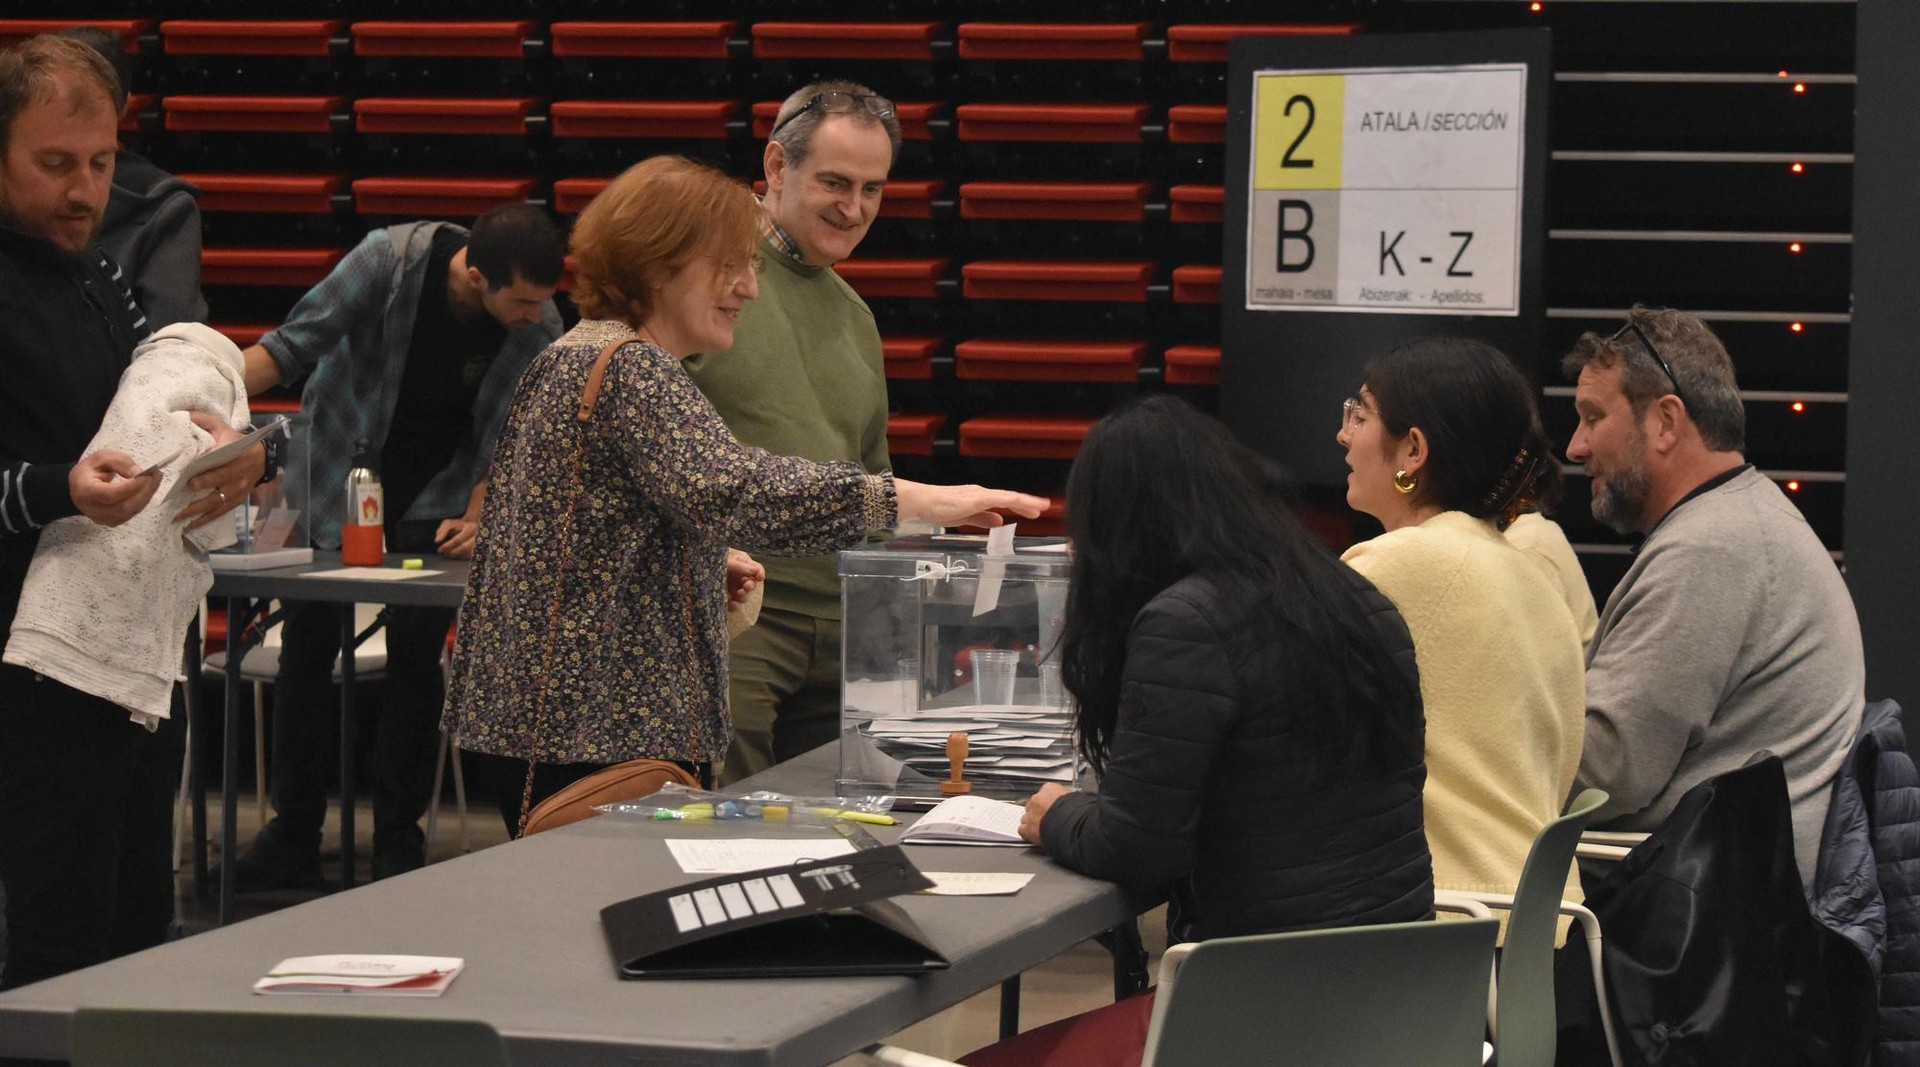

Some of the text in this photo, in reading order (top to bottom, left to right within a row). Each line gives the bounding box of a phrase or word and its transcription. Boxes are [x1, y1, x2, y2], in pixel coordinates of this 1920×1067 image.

[1280, 94, 1315, 168] 2
[1360, 111, 1420, 132] ATALA
[1276, 198, 1315, 273] B
[1379, 231, 1405, 276] K
[1446, 231, 1473, 277] Z
[1256, 288, 1293, 300] mahaia
[1303, 289, 1333, 300] mesa
